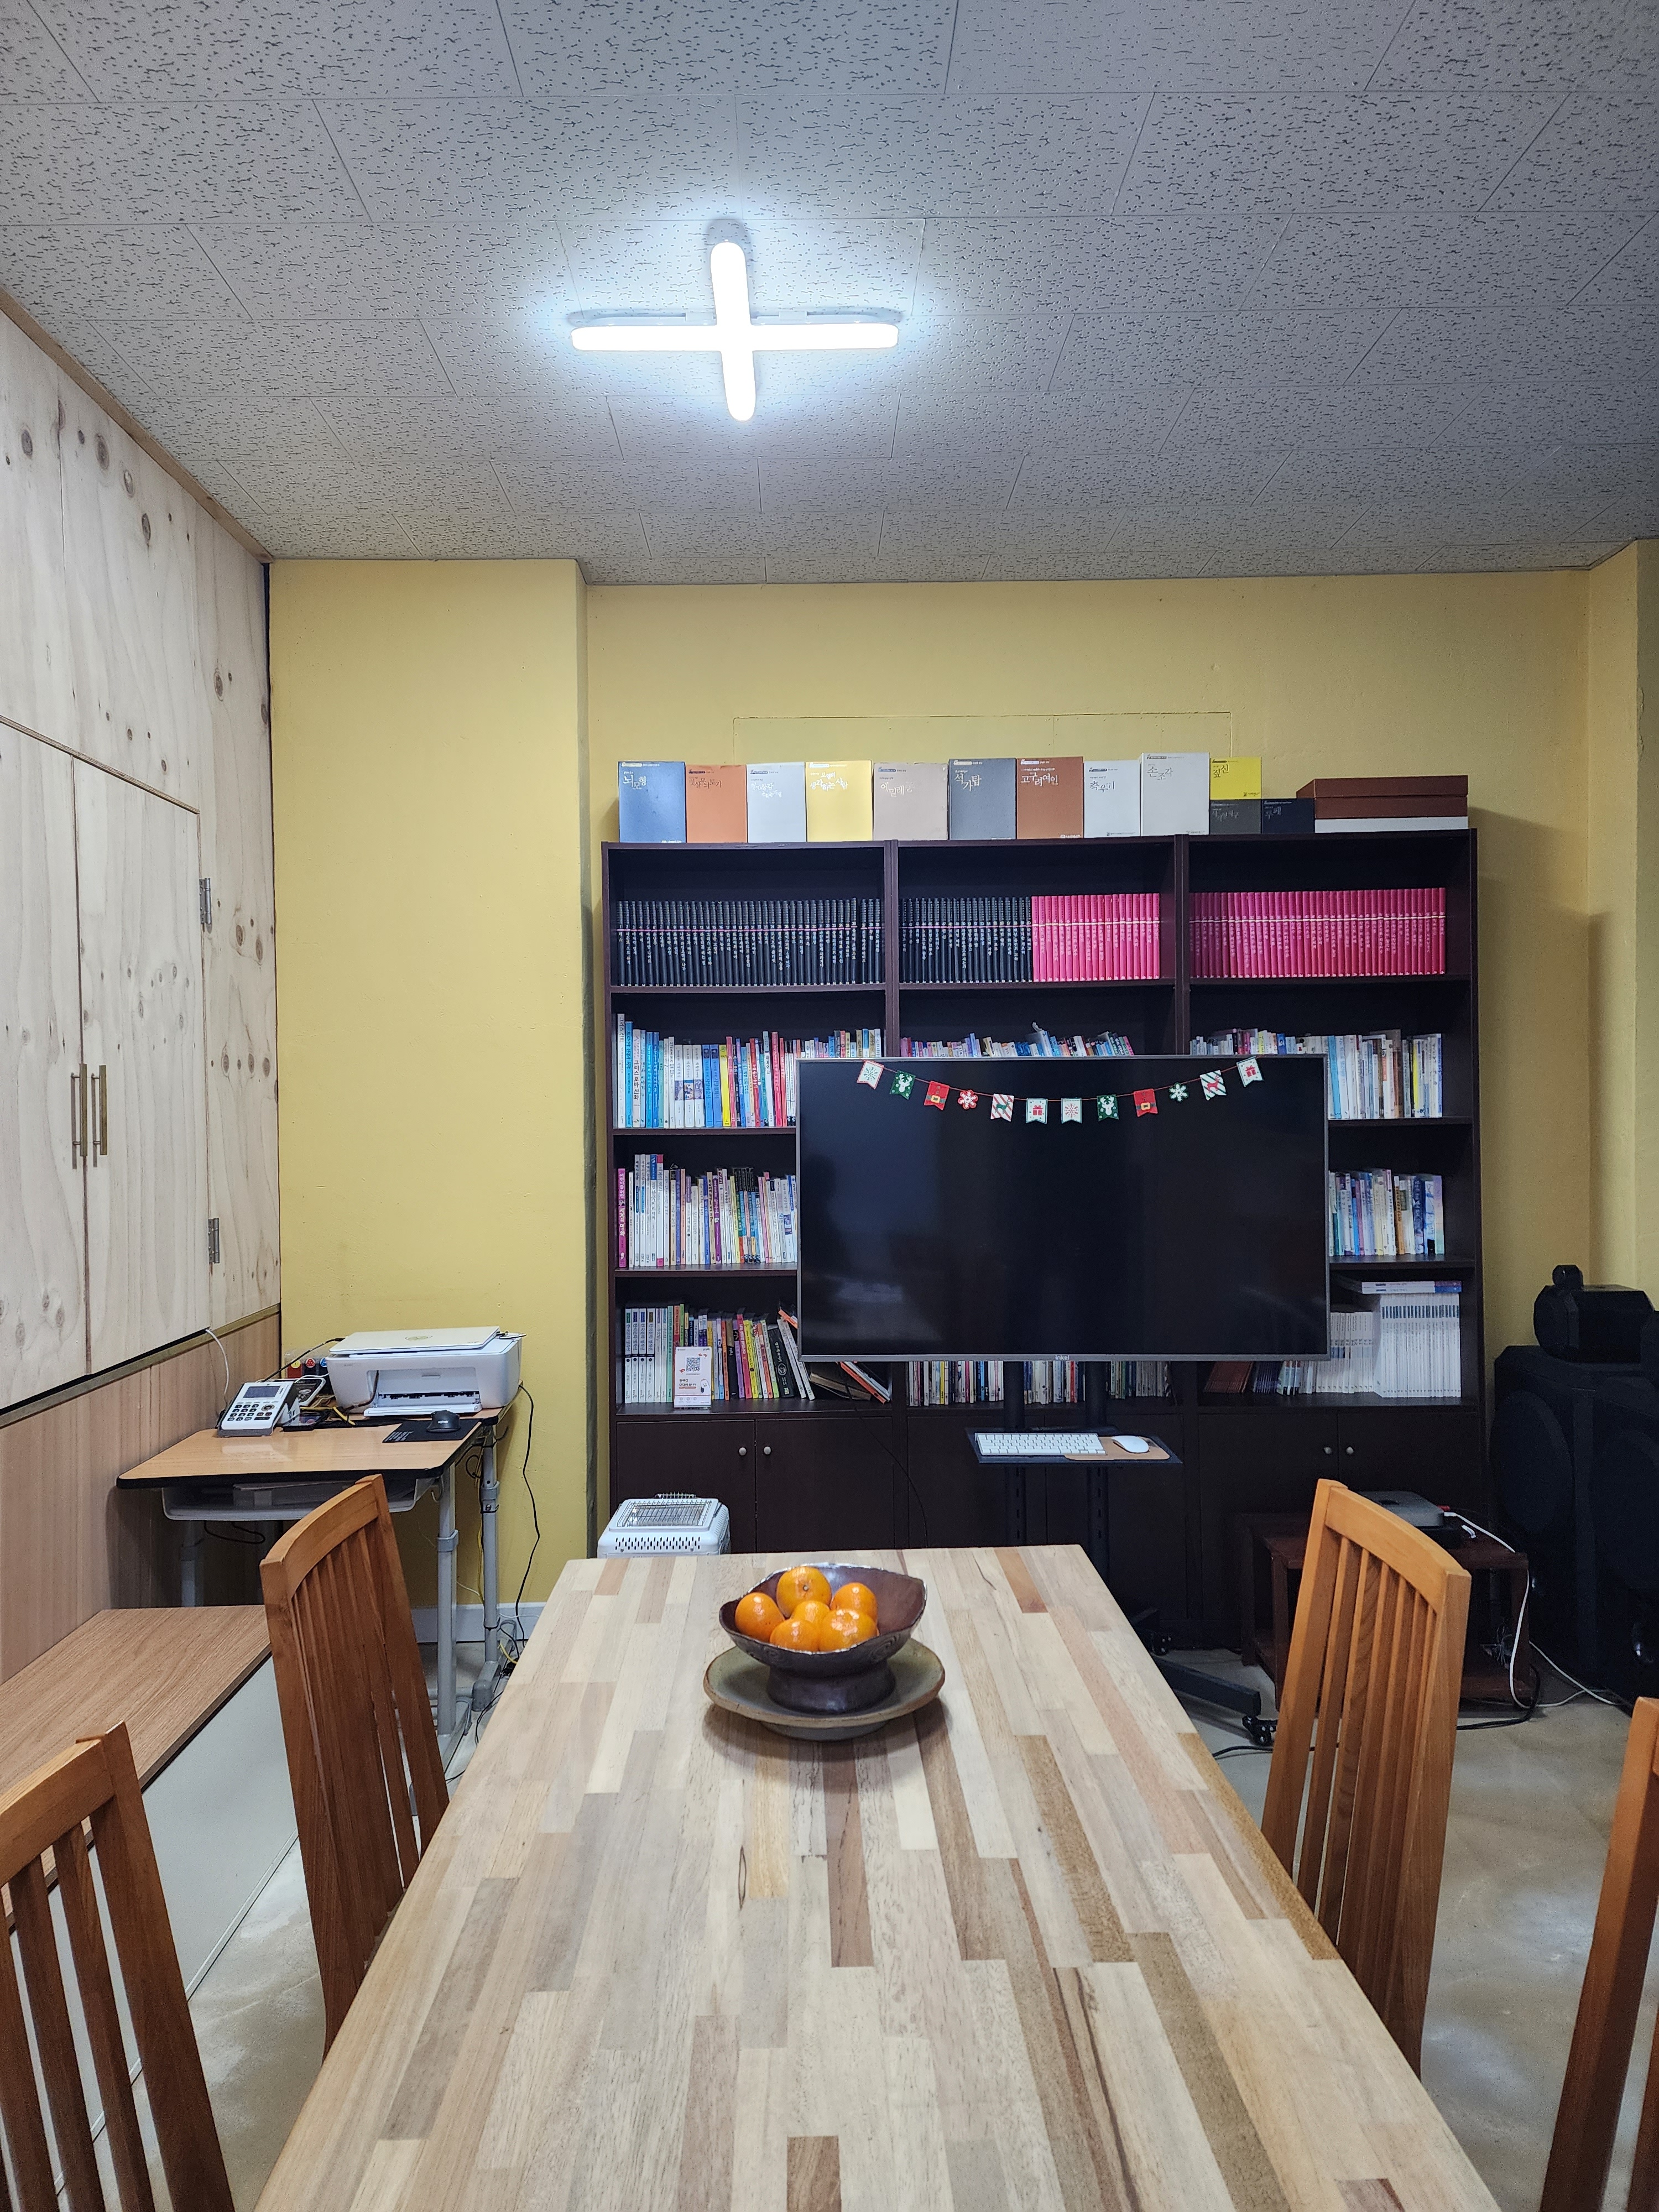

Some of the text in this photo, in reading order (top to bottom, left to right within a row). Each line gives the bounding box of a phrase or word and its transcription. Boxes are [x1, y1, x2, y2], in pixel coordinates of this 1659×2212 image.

[623, 774, 646, 789] 뇌모형
[810, 777, 848, 791] 생각하는 사람
[954, 773, 982, 792] 석가탑
[1021, 771, 1058, 786] 고구려여인
[1090, 780, 1115, 792] 측우기
[634, 1077, 639, 1088] 로마
[634, 1089, 639, 1100] 신화
